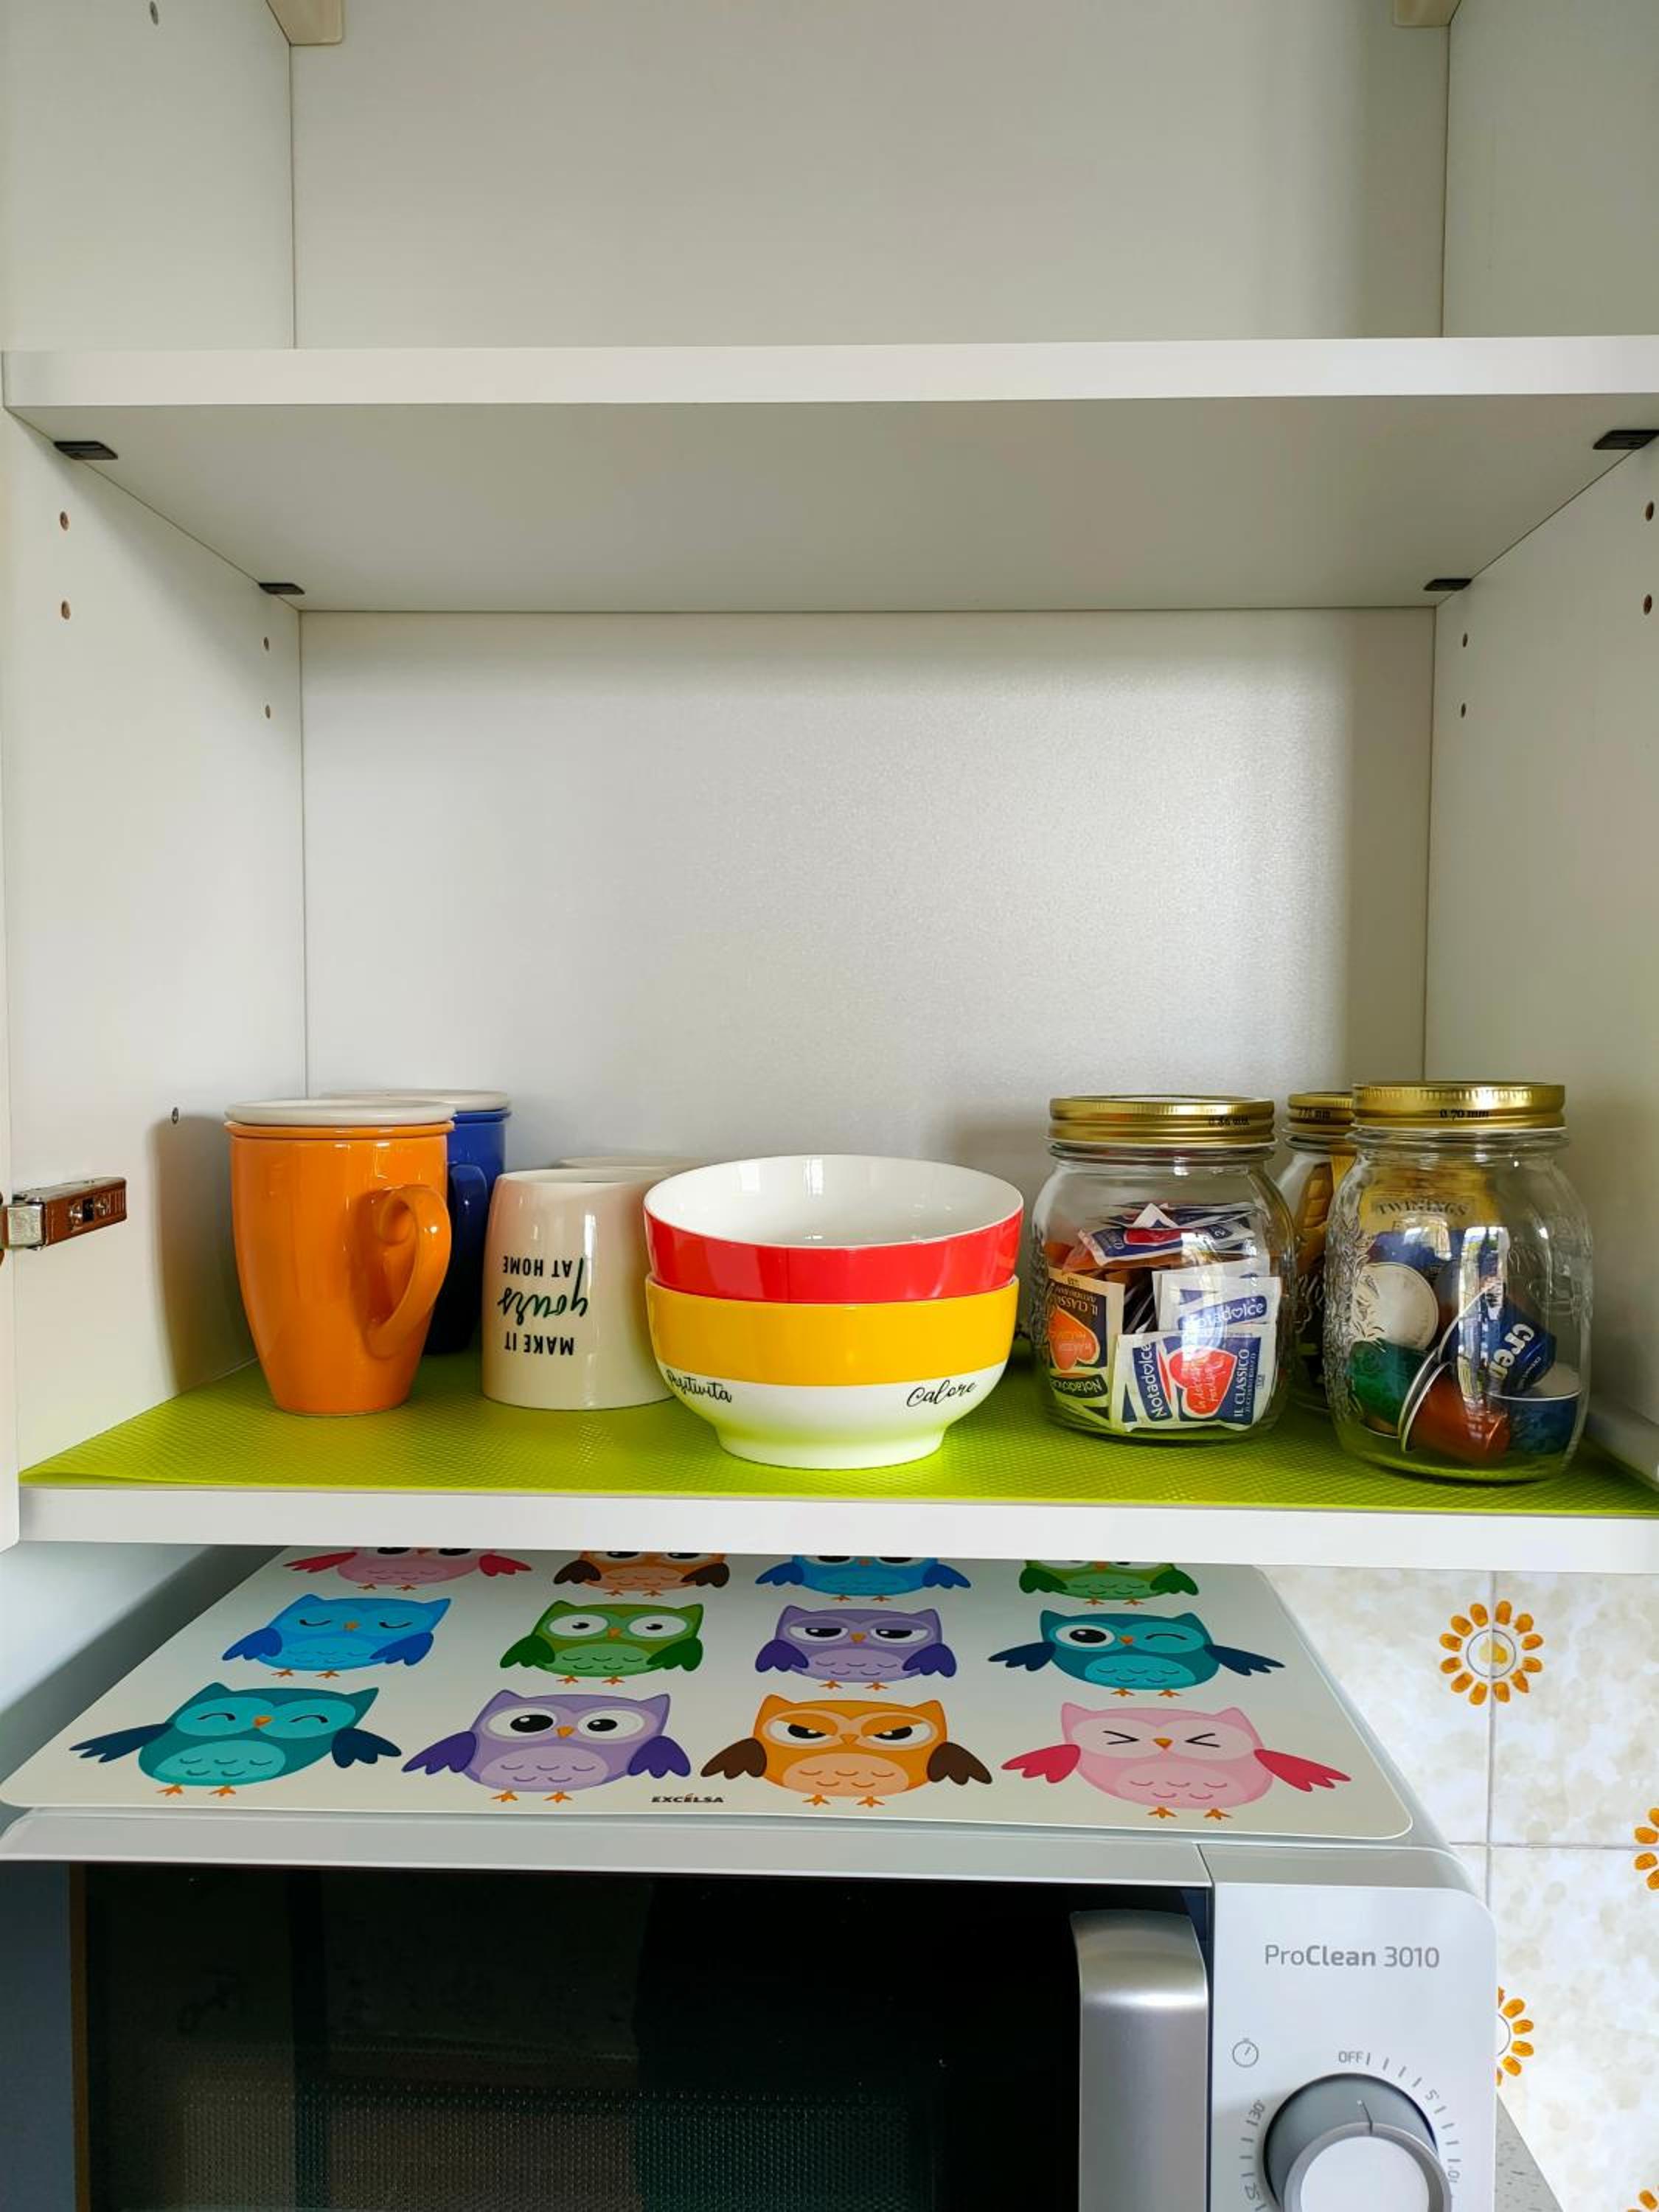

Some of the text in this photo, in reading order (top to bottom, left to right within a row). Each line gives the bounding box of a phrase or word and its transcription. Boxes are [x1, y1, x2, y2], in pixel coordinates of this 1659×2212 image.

[503, 1256, 573, 1278] AT HOME
[497, 1256, 588, 1326] yours
[504, 1331, 574, 1356] MAKE IT
[1138, 1343, 1167, 1417] Notadolce
[1235, 1349, 1251, 1405] CLASSICO
[906, 1379, 978, 1408] Calore
[1234, 1408, 1245, 1417] IL
[1265, 1944, 1440, 1968] ProClean 3010
[1338, 2050, 1363, 2064] OFF
